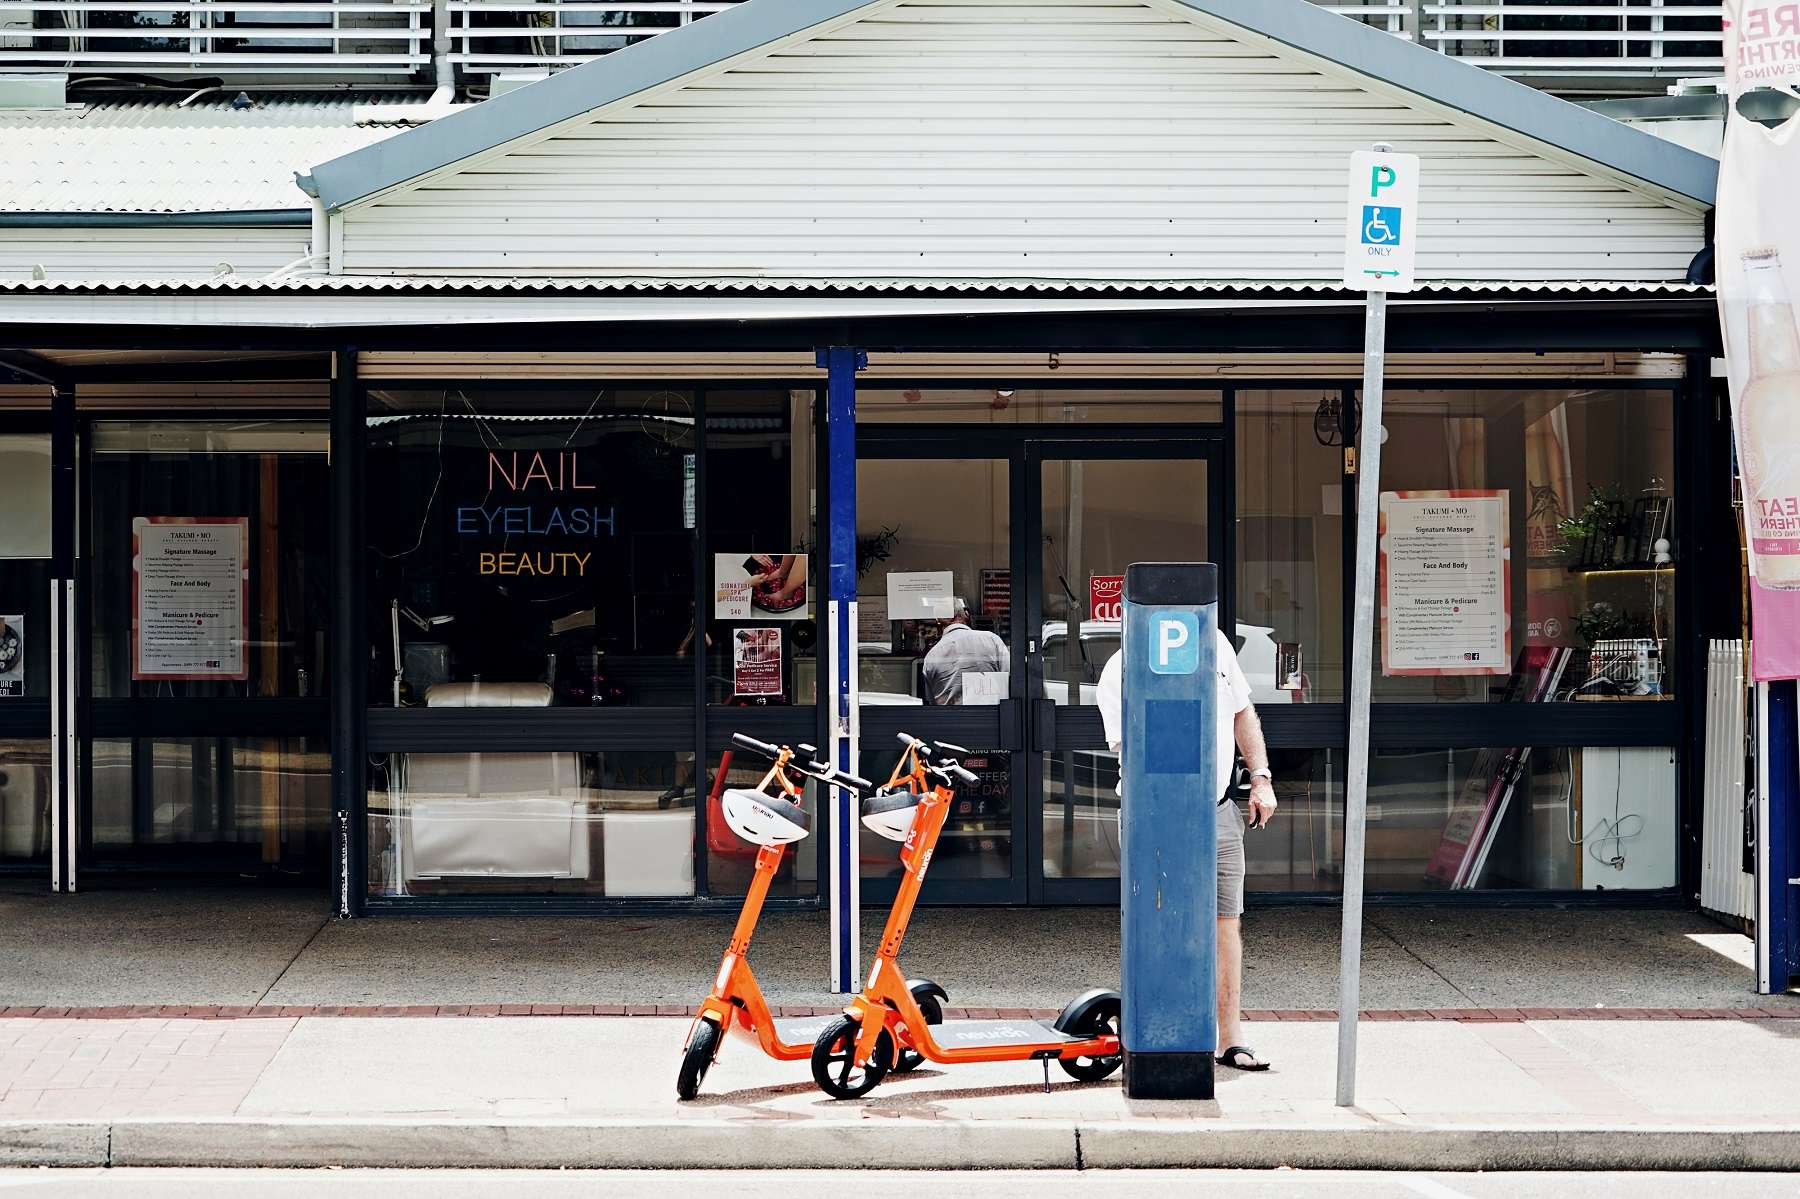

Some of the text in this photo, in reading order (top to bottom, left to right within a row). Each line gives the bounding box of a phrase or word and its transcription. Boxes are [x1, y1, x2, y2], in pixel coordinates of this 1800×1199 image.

[1370, 166, 1396, 198] P
[1368, 246, 1392, 256] ONLY
[488, 451, 597, 491] NAIL
[457, 506, 614, 537] EYELASH
[480, 551, 592, 576] BEAUTY
[1159, 619, 1189, 666] P
[977, 772, 1008, 782] FFER
[982, 784, 1009, 796] DAY
